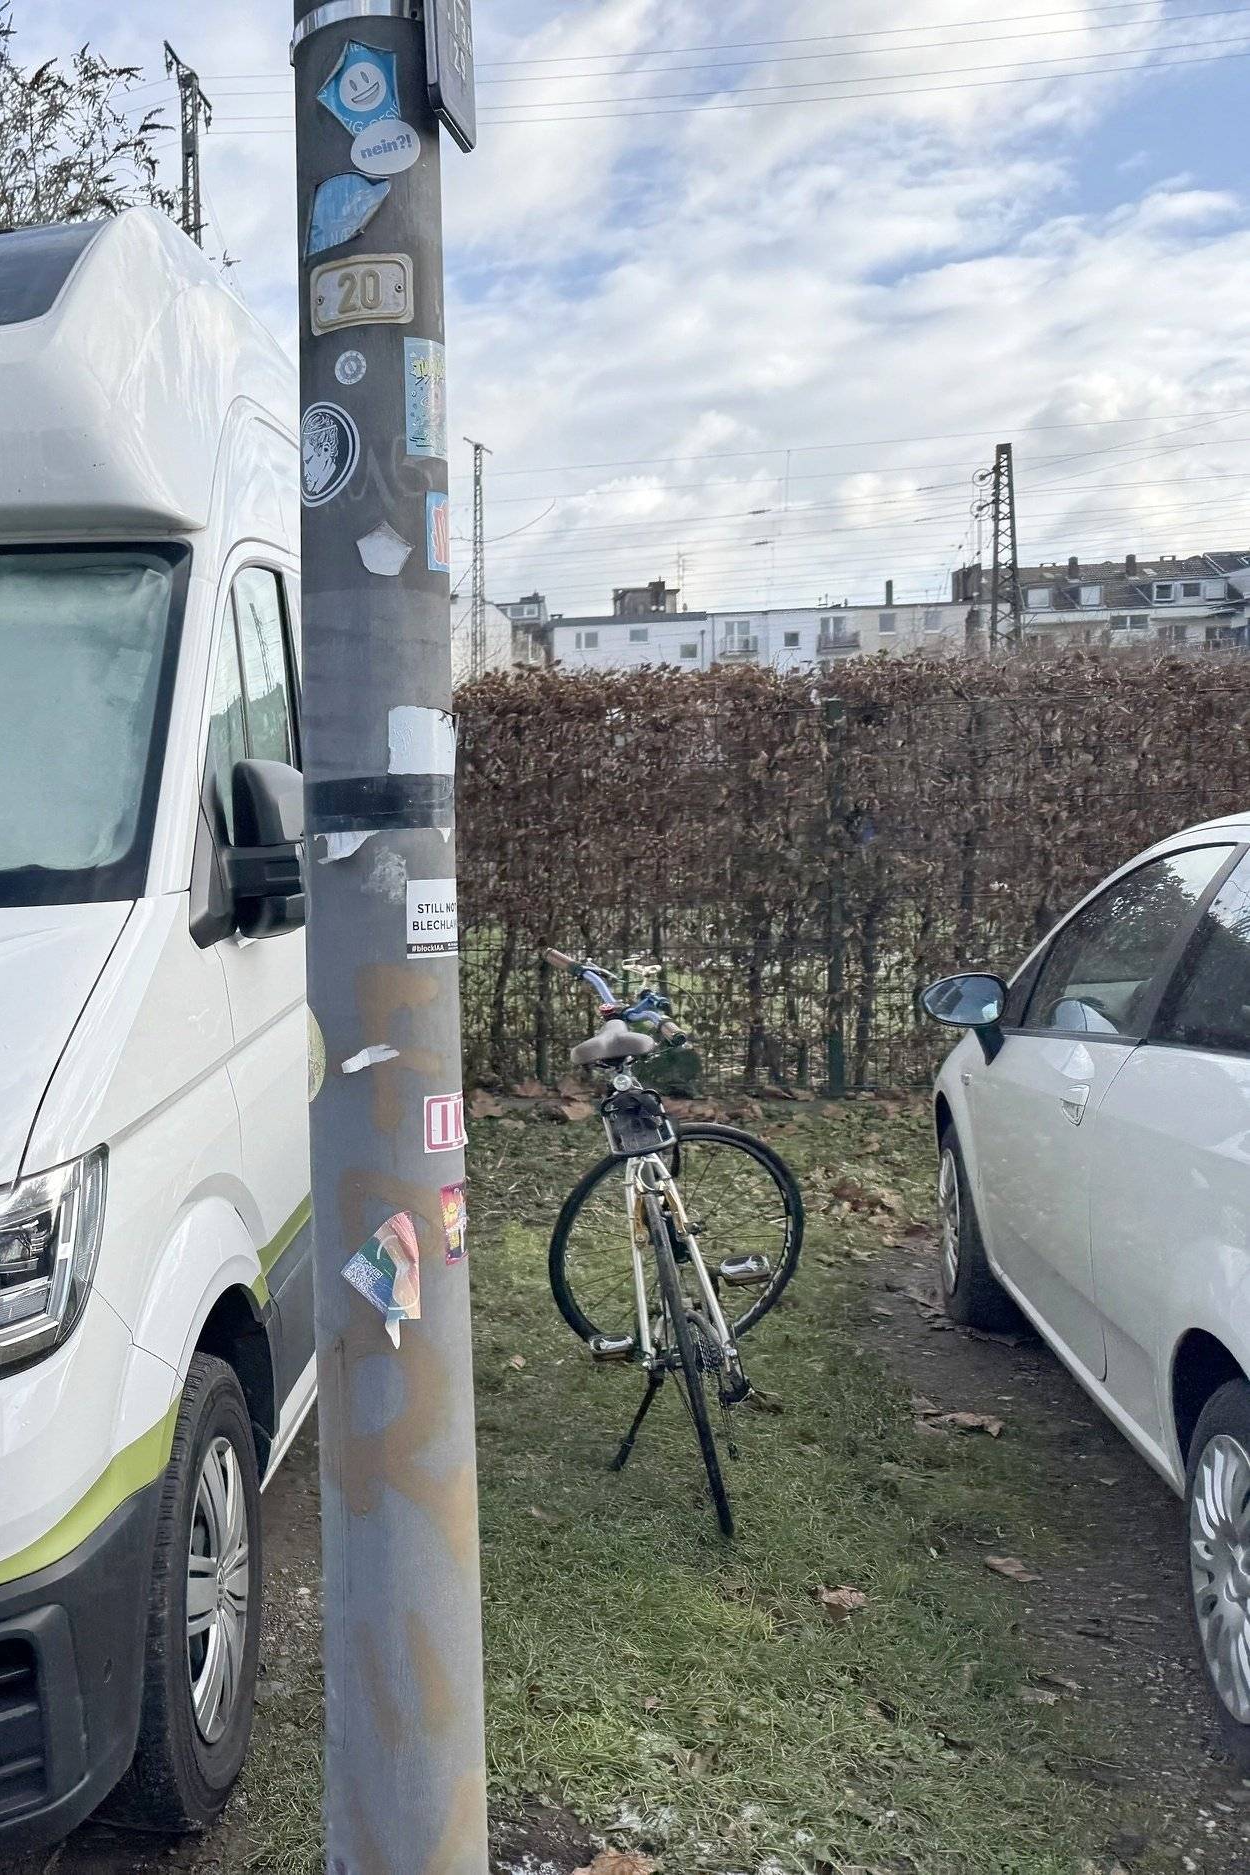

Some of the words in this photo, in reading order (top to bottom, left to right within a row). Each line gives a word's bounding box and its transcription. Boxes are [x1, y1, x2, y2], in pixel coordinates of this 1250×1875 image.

[360, 133, 413, 159] nein?!
[337, 269, 382, 314] 20
[417, 903, 445, 914] STILL
